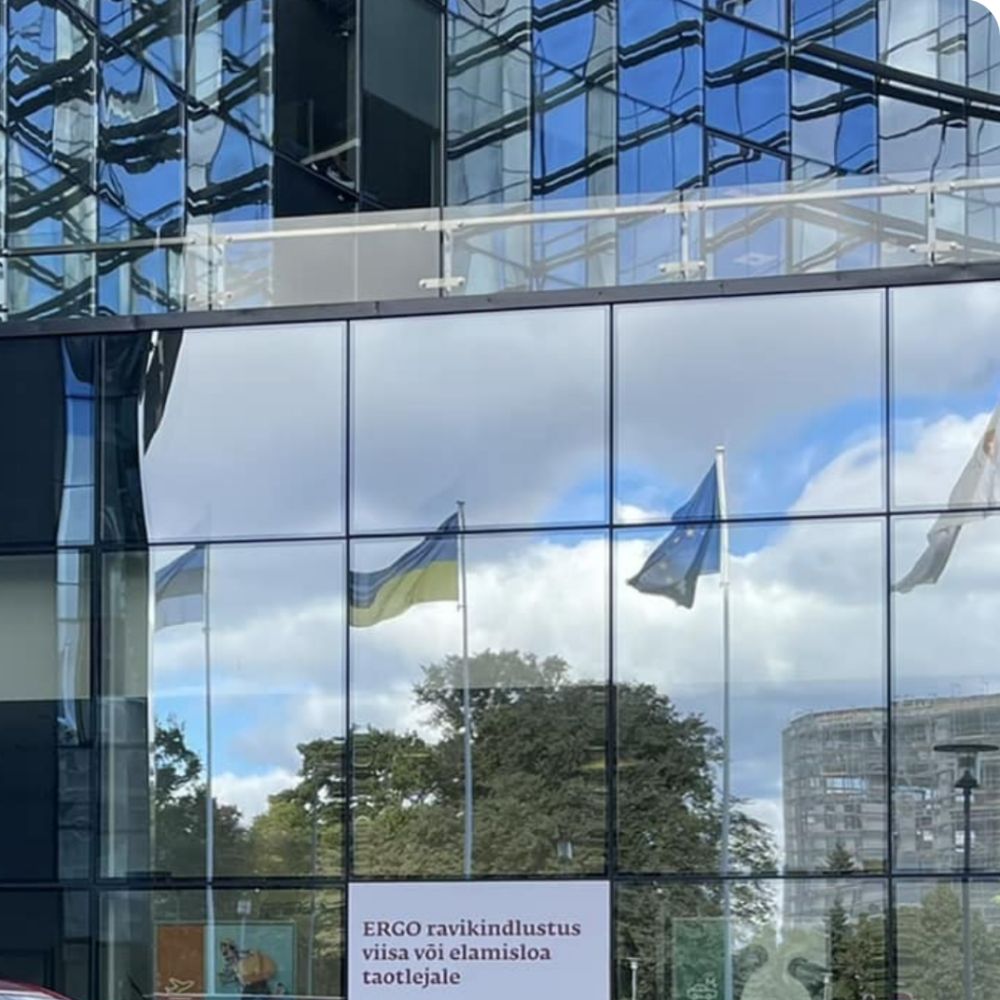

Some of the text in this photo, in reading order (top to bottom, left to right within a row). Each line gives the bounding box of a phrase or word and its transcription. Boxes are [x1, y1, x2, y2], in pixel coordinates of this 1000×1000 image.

[363, 919, 581, 937] ERGO ravikindlustus
[362, 944, 552, 961] viisa või elamisloa
[362, 968, 461, 988] taotlejale
